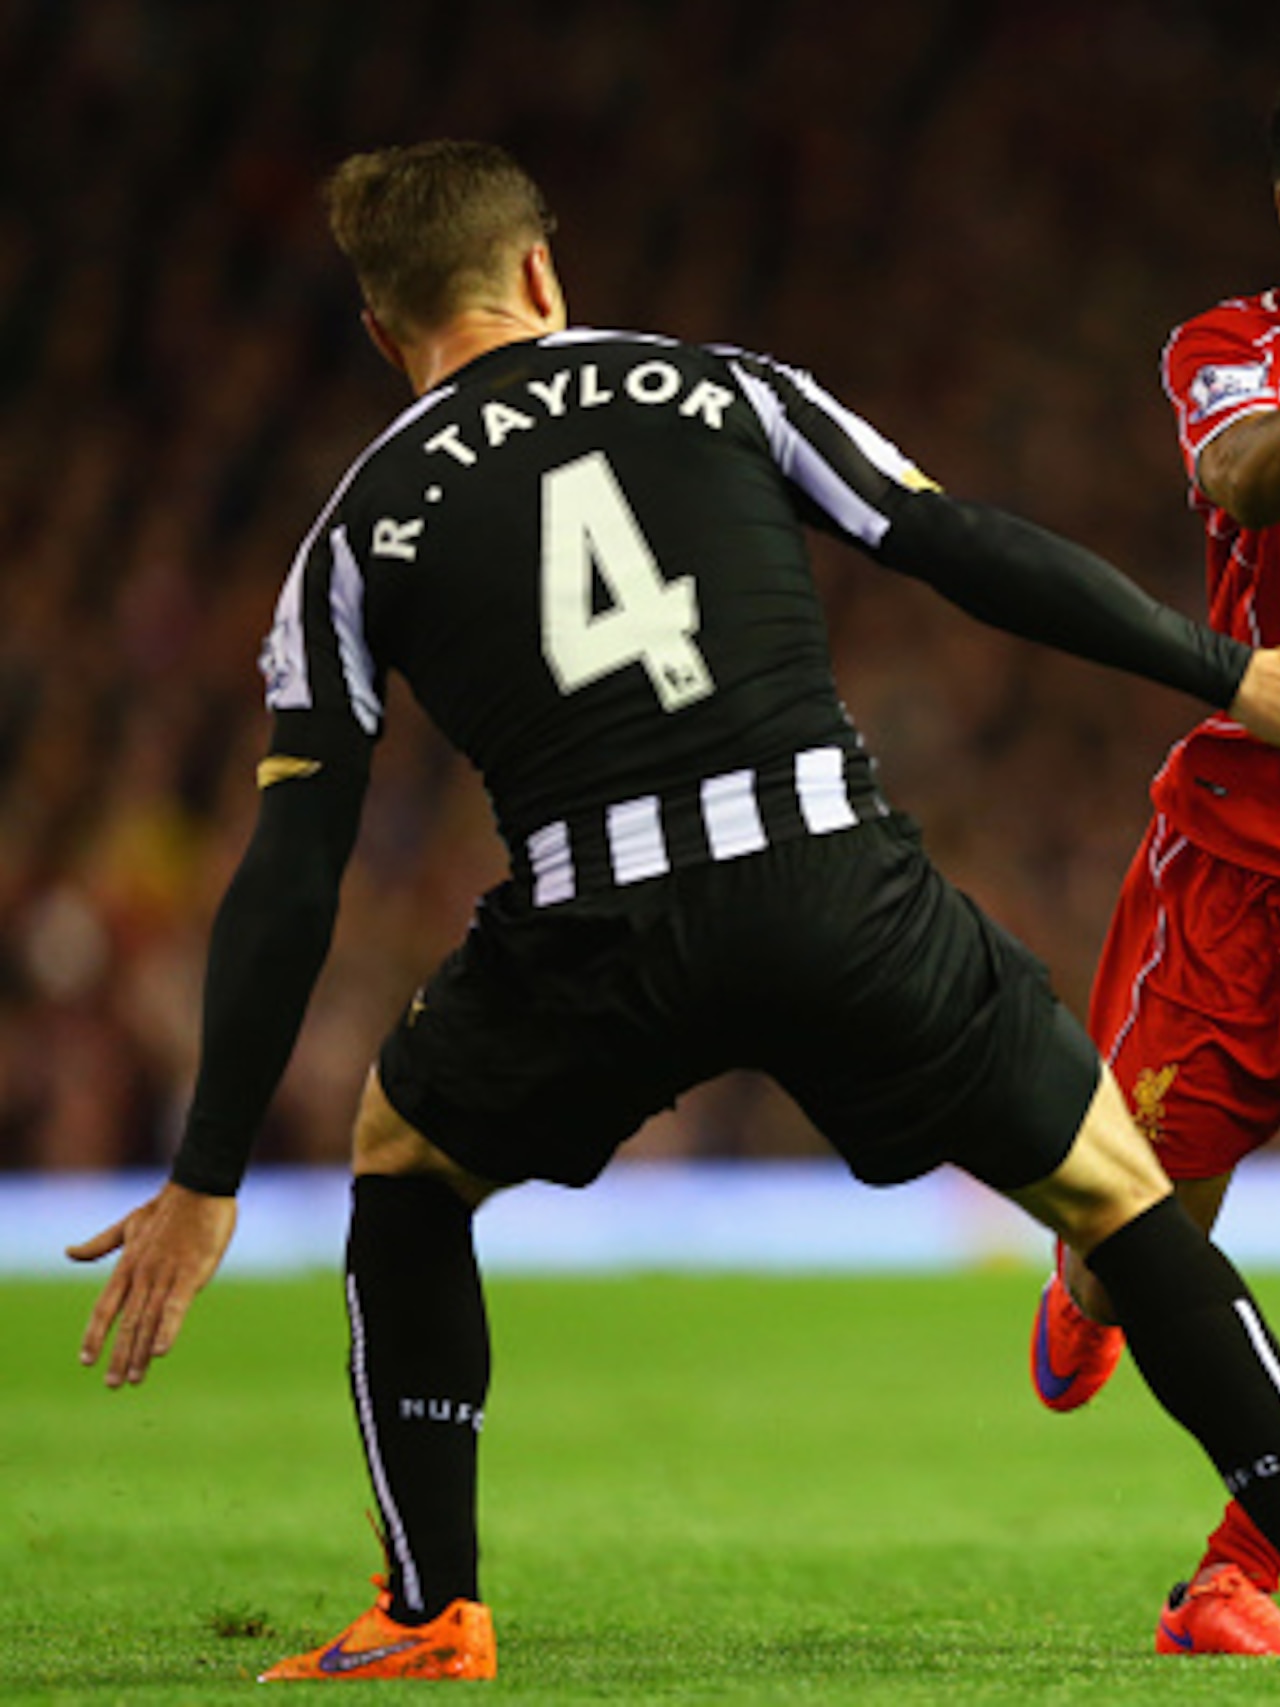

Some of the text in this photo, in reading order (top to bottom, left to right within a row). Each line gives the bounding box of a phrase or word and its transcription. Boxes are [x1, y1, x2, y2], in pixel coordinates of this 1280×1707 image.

[371, 359, 736, 563] R. TAYLOR
[541, 449, 716, 714] 4
